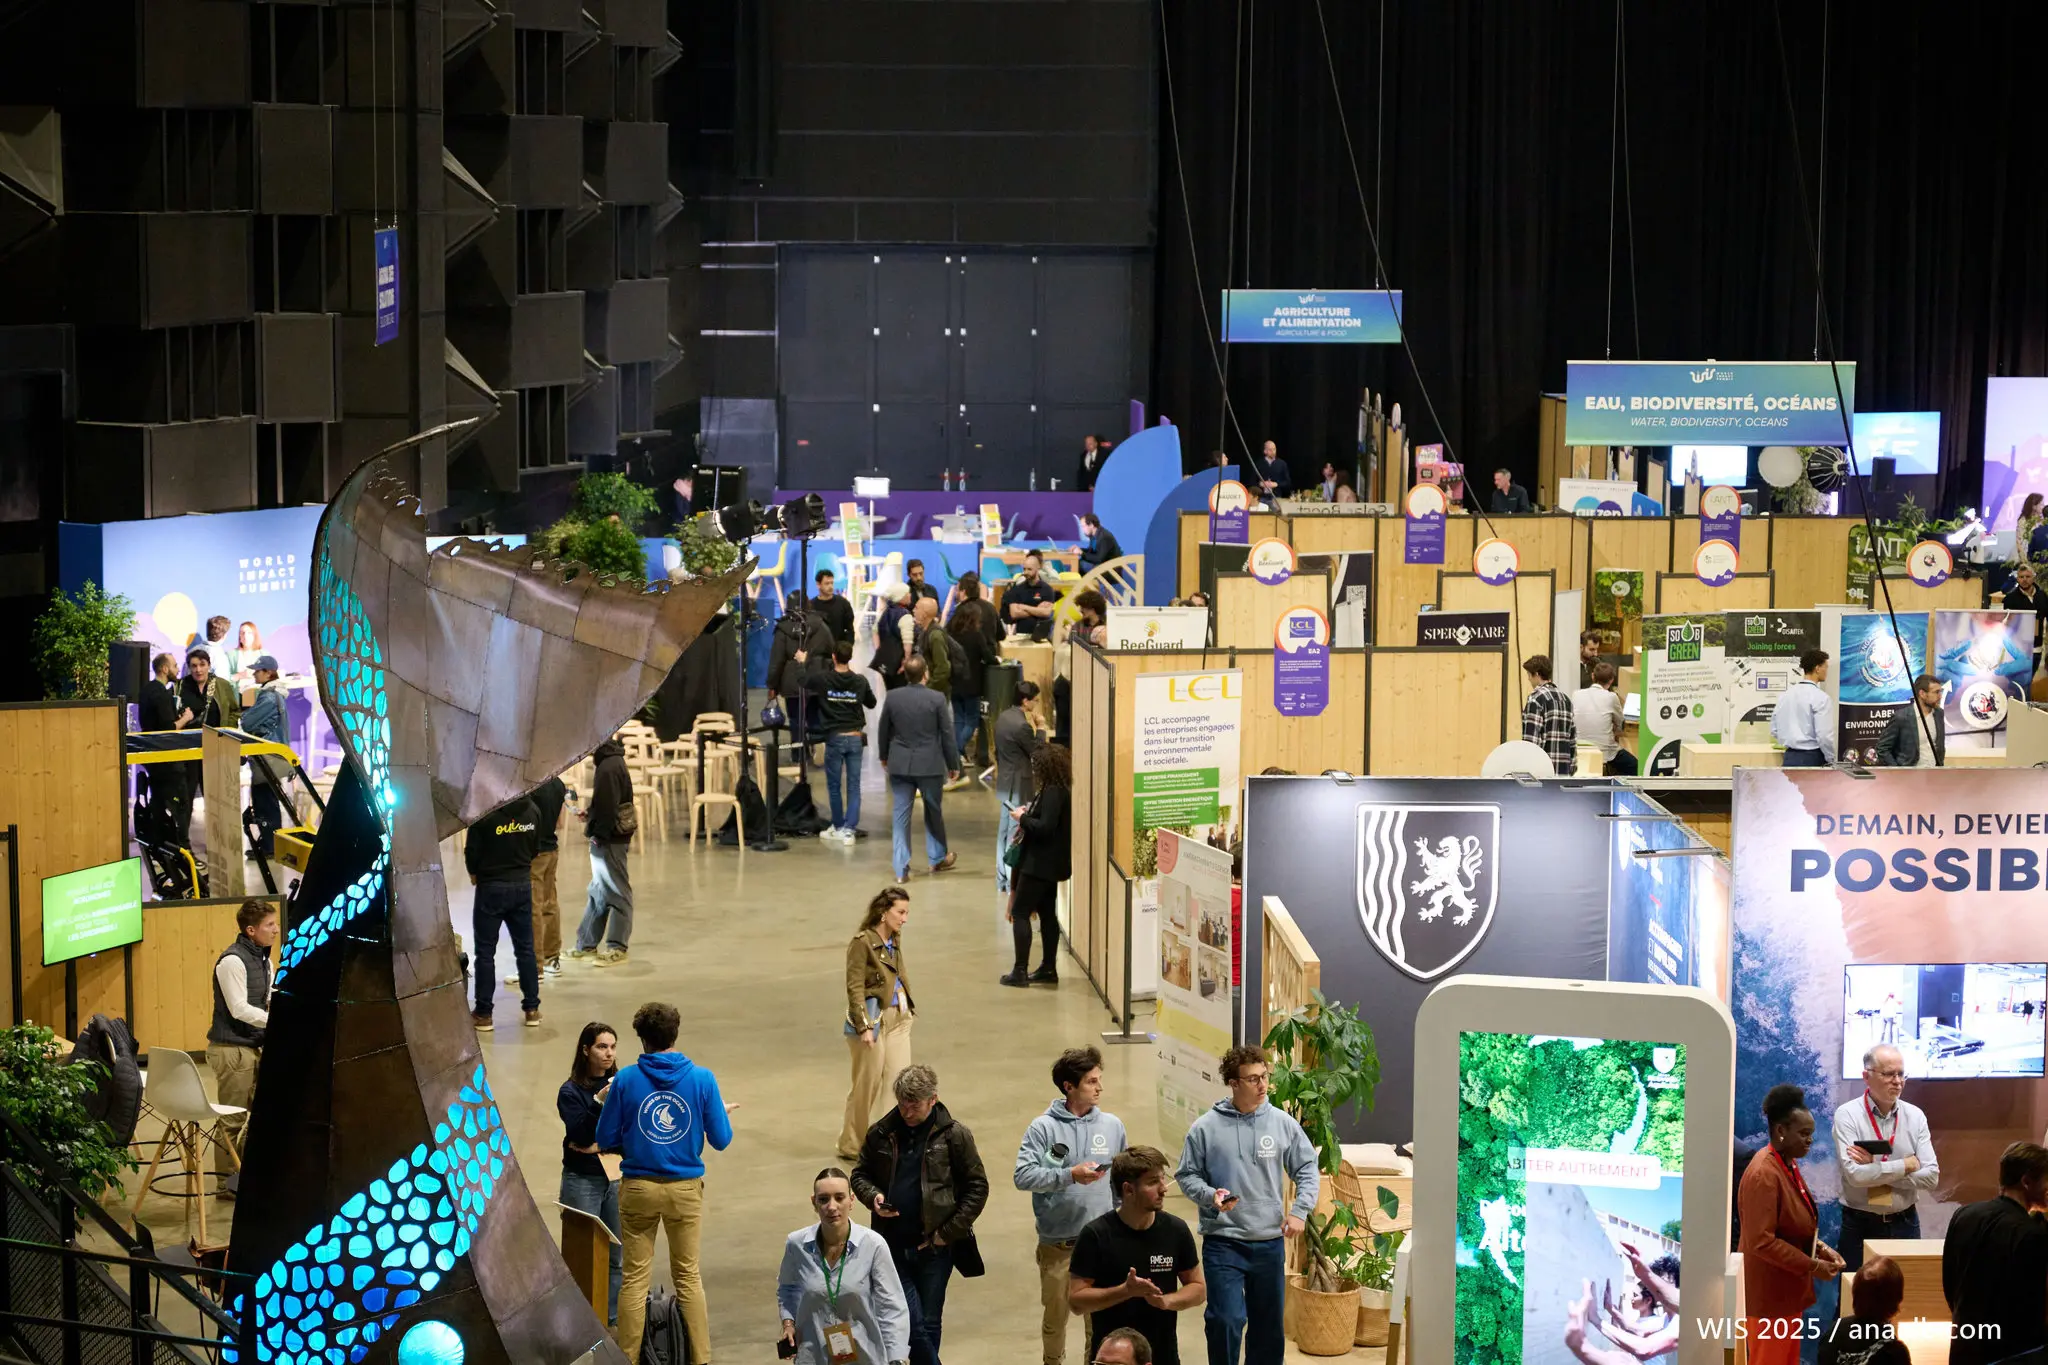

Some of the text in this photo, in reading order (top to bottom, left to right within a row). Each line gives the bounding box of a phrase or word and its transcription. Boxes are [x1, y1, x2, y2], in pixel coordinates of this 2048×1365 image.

[1274, 307, 1351, 317] AGRICULTURE
[1262, 318, 1362, 328] ET ALIMENTATION
[1585, 394, 1837, 412] EAU, BIODIVERSITÉ, OCÉANS
[1631, 417, 1789, 428] WATER, BIODIVERSITY, OCEANS
[239, 554, 296, 569] WORLD
[239, 567, 296, 581] IMPACT
[239, 580, 296, 594] SUMMIT
[1291, 621, 1313, 629] LCL
[1669, 628, 1700, 642] SO B
[1120, 638, 1184, 649] BeeGuard
[1747, 641, 1796, 651] Joining forces
[1669, 642, 1699, 660] GREEN
[1168, 675, 1242, 702] LCL
[1144, 715, 1210, 725] LCL accompagne
[1144, 723, 1235, 736] les entreprises engagées
[1144, 734, 1215, 746] dans leur transition
[1144, 744, 1212, 756] environnementale
[1144, 756, 1189, 766] et sociétale.
[1815, 813, 2048, 839] DEMAIN, DEVIE
[1790, 847, 2048, 893] POSSIB
[643, 1098, 655, 1114] WINGS
[672, 1097, 686, 1113] OCEAN
[1506, 1157, 1649, 1178] ABITER AUTREMENT
